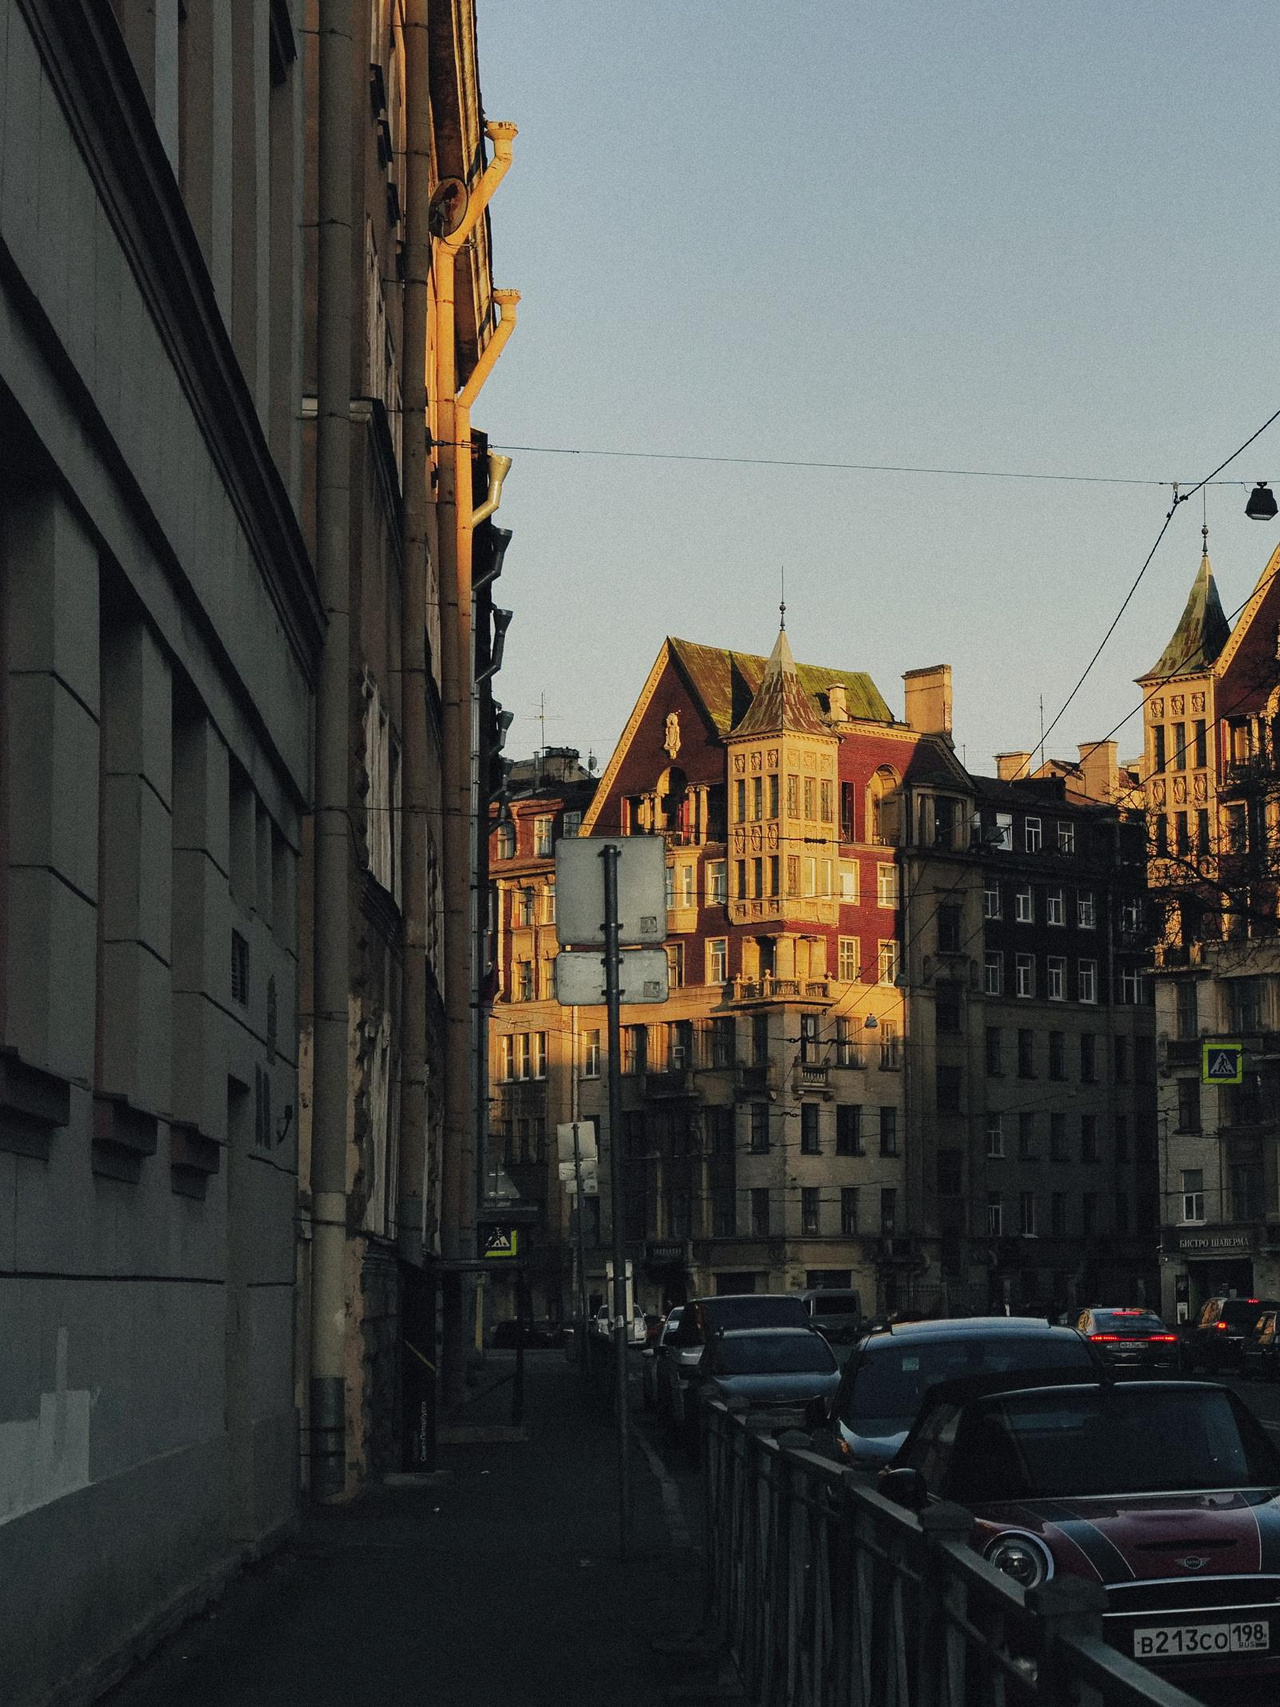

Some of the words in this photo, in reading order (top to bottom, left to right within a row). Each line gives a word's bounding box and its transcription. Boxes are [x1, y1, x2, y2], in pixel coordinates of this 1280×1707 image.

[1180, 1239, 1209, 1249] БИСТРО
[1211, 1237, 1250, 1247] ШАВЕРМА
[1141, 1629, 1228, 1654] В213СО
[1232, 1624, 1264, 1642] 198
